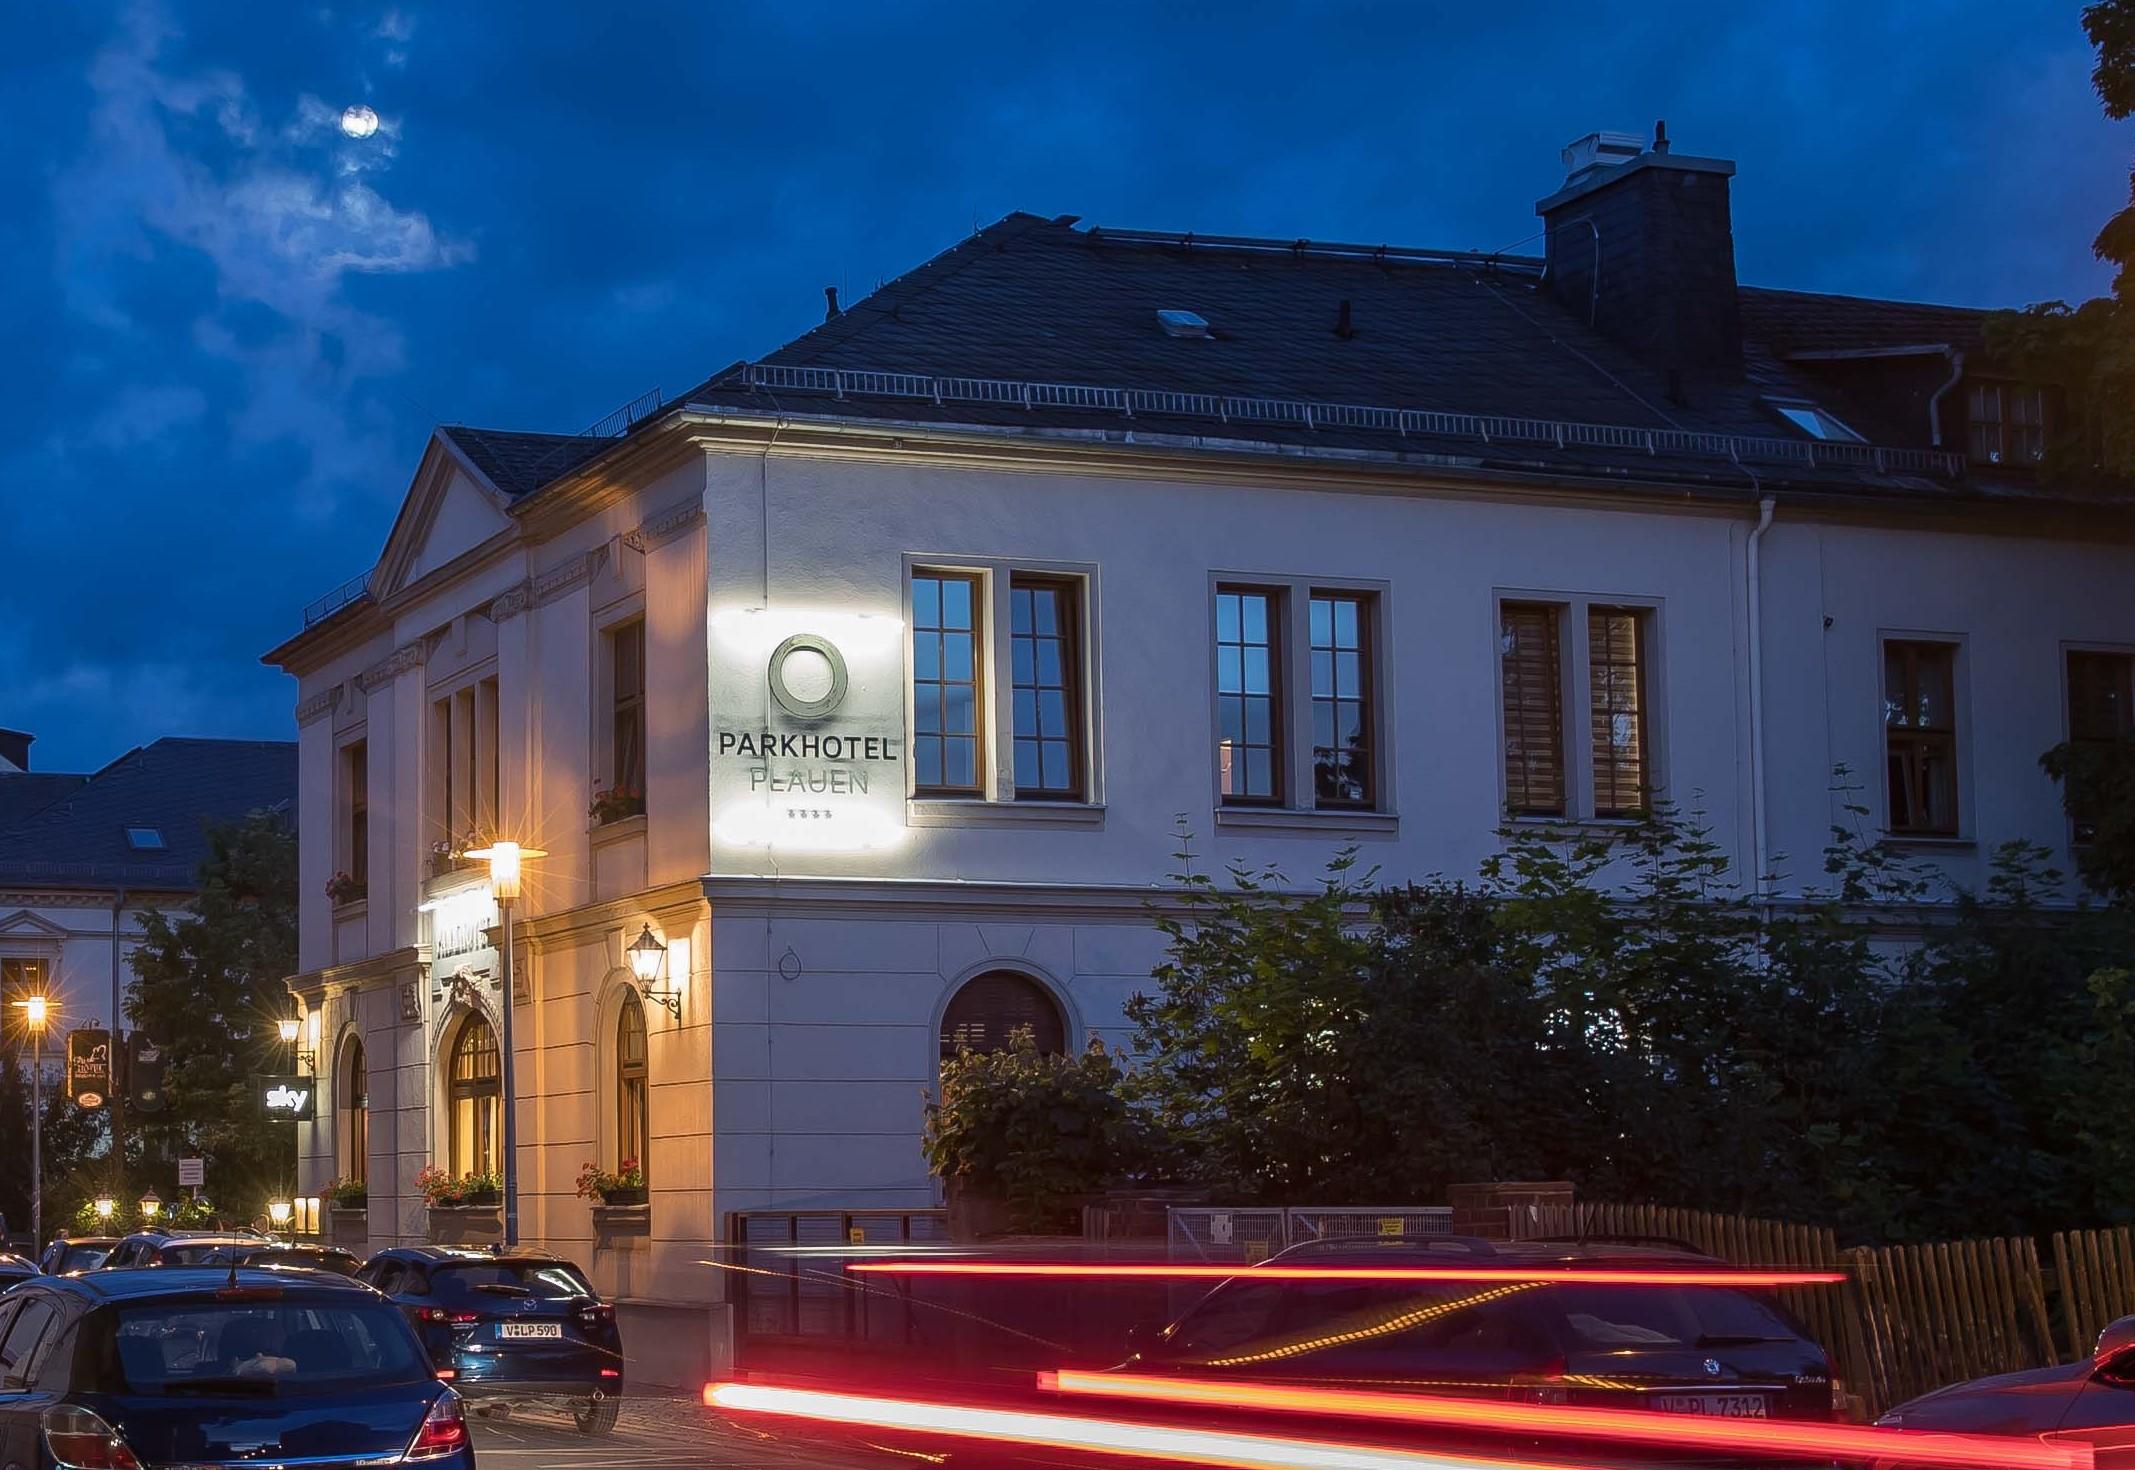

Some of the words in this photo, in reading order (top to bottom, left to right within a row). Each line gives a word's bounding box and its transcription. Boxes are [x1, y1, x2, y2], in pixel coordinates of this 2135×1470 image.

[719, 732, 897, 760] PARKHOTEL
[750, 767, 869, 794] PLAUEN
[266, 1084, 308, 1112] sky
[1717, 1397, 1764, 1418] 7312
